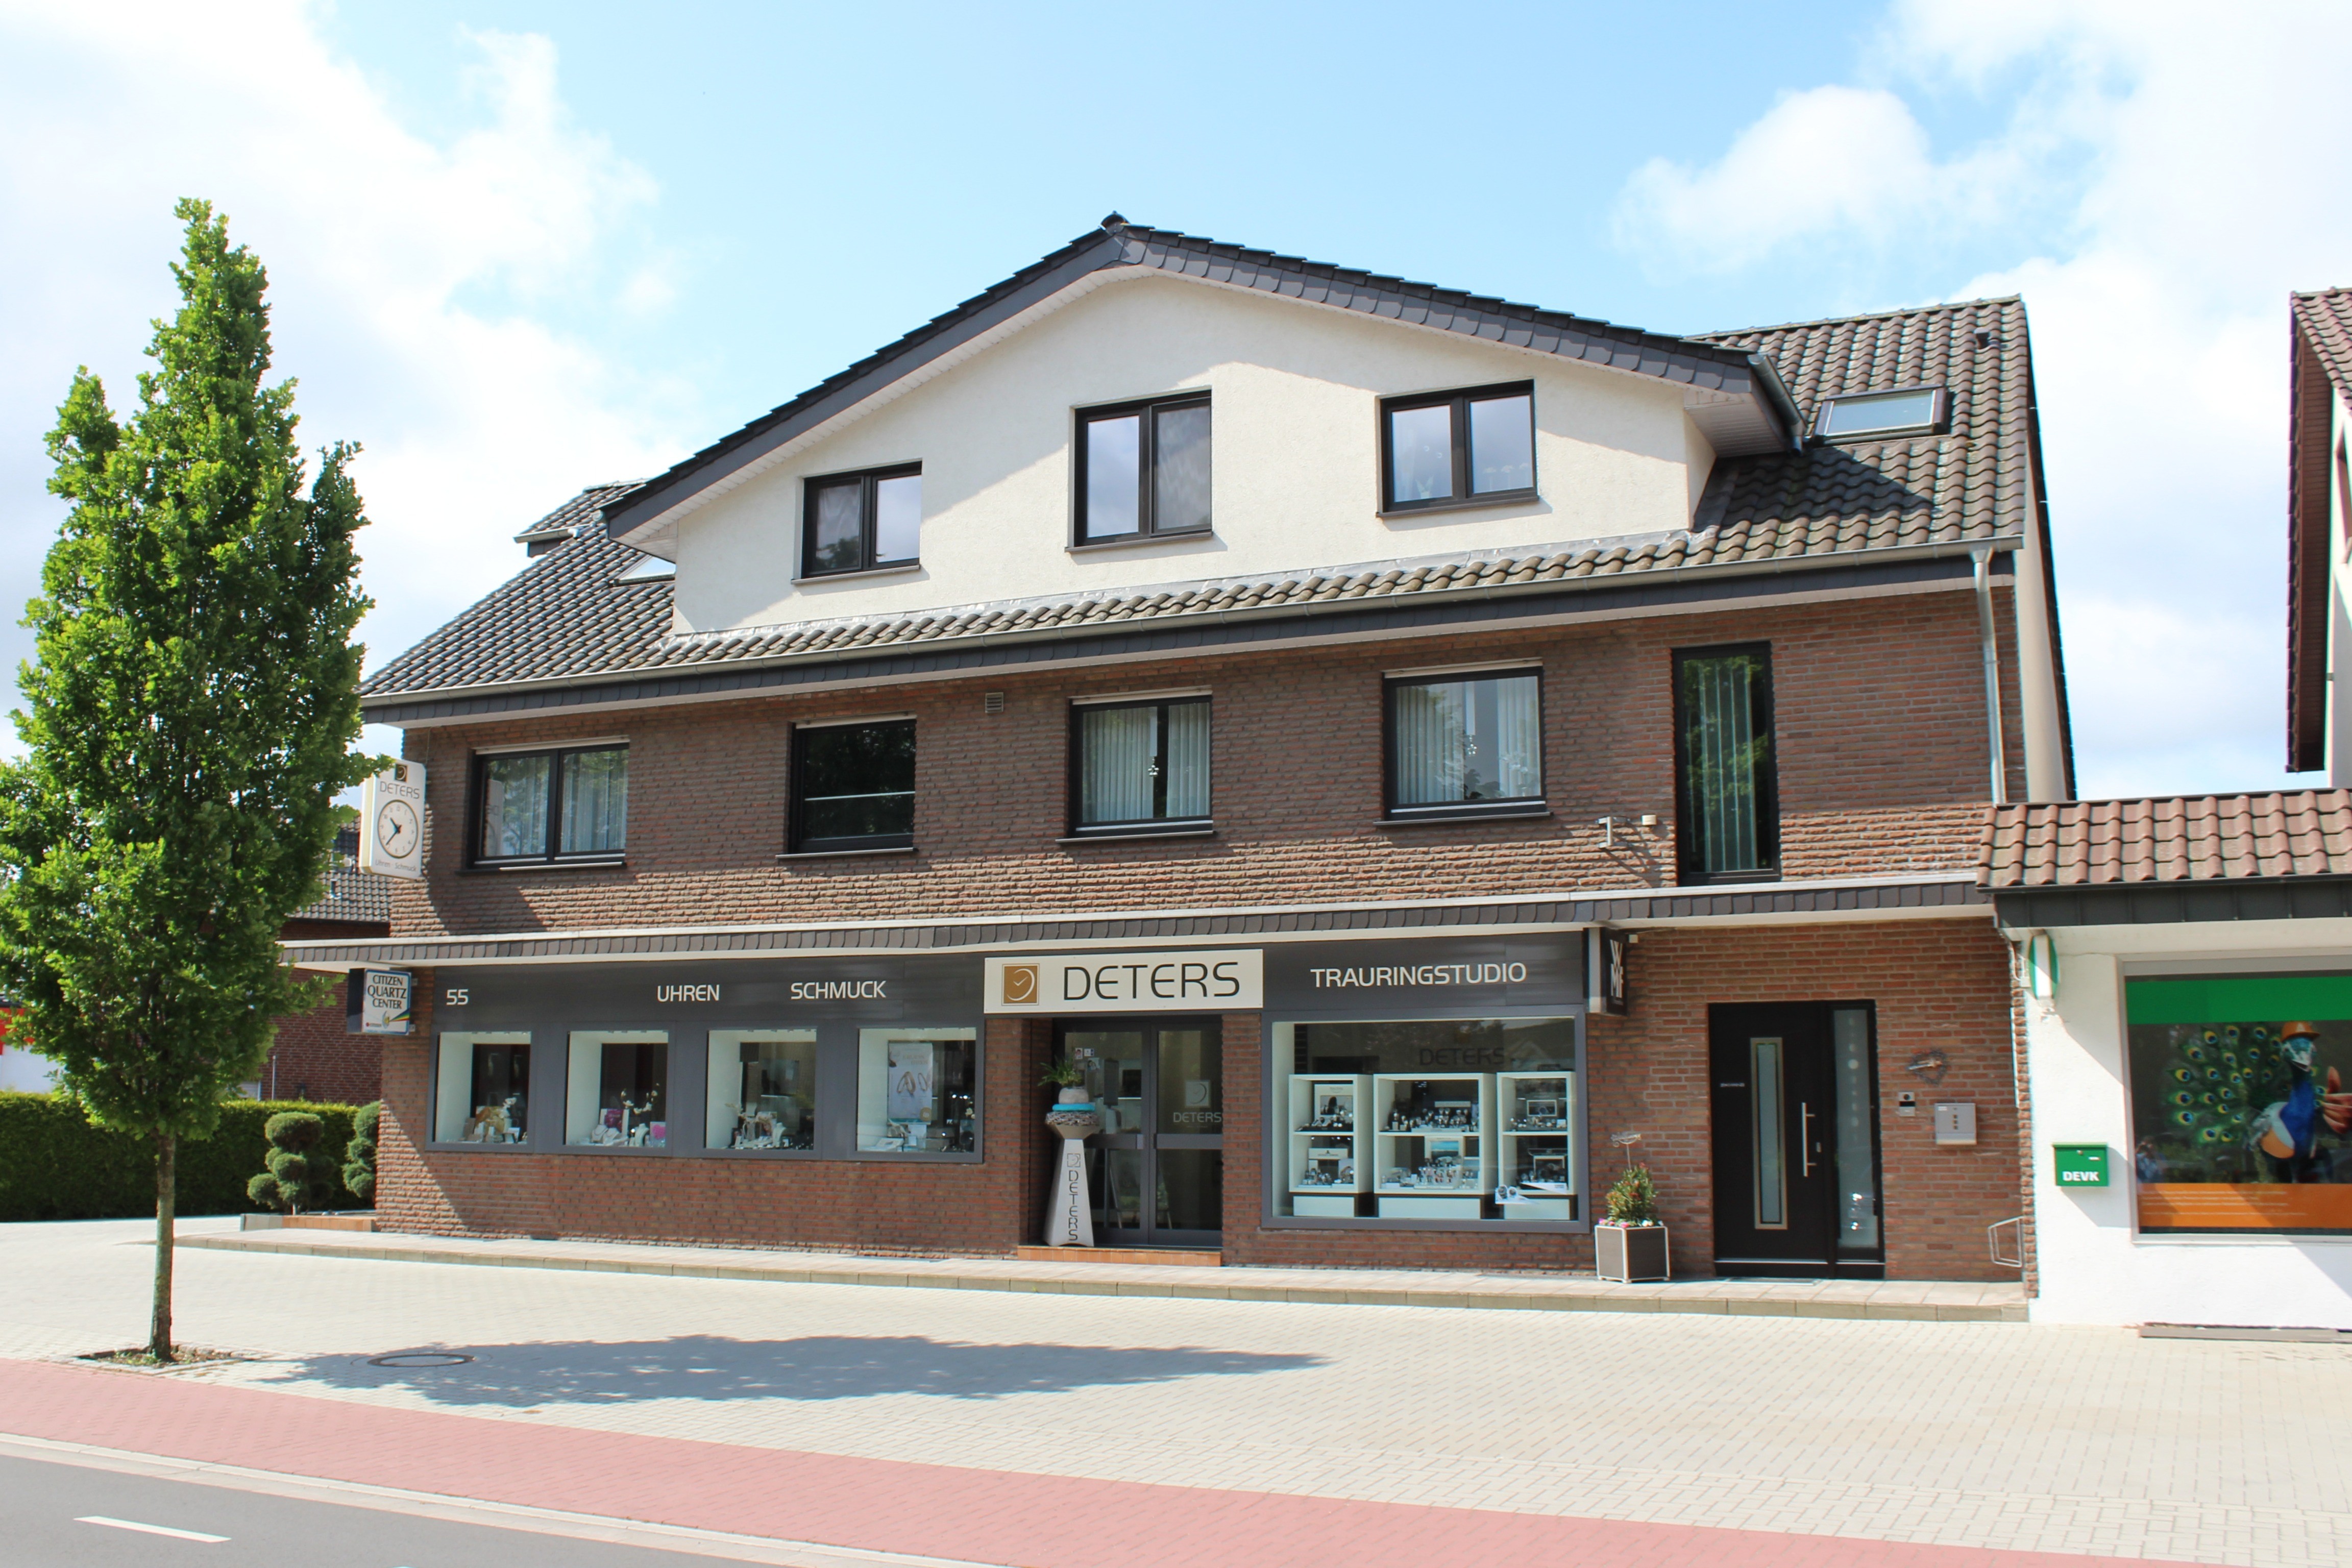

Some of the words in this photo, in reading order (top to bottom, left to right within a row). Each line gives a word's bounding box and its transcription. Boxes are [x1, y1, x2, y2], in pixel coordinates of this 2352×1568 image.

[380, 781, 420, 799] DETERS
[375, 859, 390, 868] Uhren
[395, 862, 416, 872] Schmuck
[373, 974, 403, 986] CITIZEN
[1064, 962, 1240, 1000] DETERS
[1310, 962, 1527, 988] TRAURINGSTUDIO
[367, 985, 407, 999] QUARTZ
[446, 989, 469, 1006] 55
[657, 984, 720, 1002] UHREN
[791, 981, 887, 999] SCHMUCK
[372, 998, 402, 1009] CENTER
[1420, 1047, 1505, 1066] DETERS
[1173, 1112, 1222, 1122] DETERS
[2062, 1171, 2100, 1182] DEVK
[1068, 1170, 1079, 1241] DETERS
